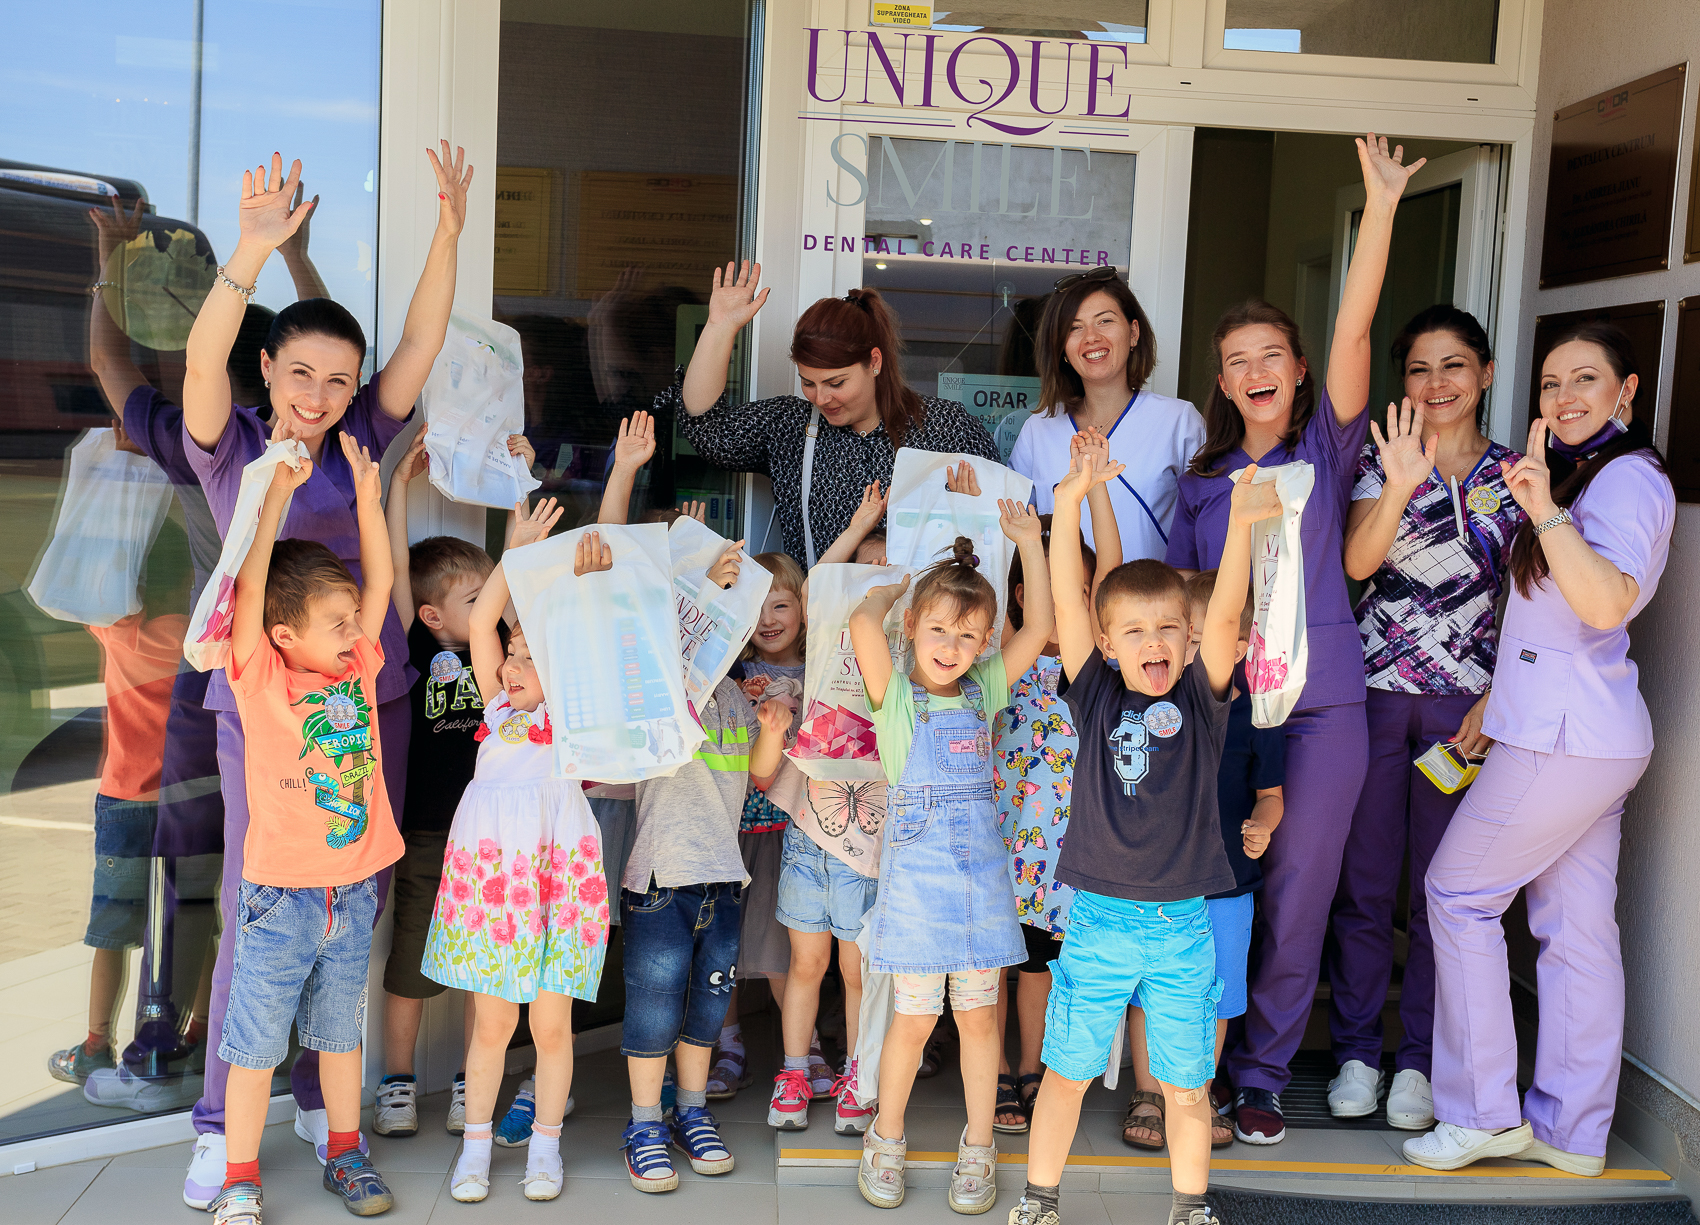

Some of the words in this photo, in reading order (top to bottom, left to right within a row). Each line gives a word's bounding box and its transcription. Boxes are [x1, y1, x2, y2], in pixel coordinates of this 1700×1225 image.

[877, 10, 927, 19] SUPRAVEGHEATA
[803, 28, 1131, 135] UNIQUE
[1611, 131, 1655, 158] CENTRUM
[826, 133, 1093, 223] SMILE
[803, 233, 906, 256] DENTAL
[922, 240, 990, 260] CARE
[1006, 245, 1110, 267] CENTER
[973, 390, 1028, 409] ORAR
[1004, 431, 1018, 442] Vin
[439, 674, 455, 682] SMILE
[426, 666, 486, 719] GA
[1158, 726, 1177, 737] SMILE
[1109, 717, 1149, 784] 3
[344, 766, 369, 781] BRAZIL
[279, 778, 307, 792] CHILL!
